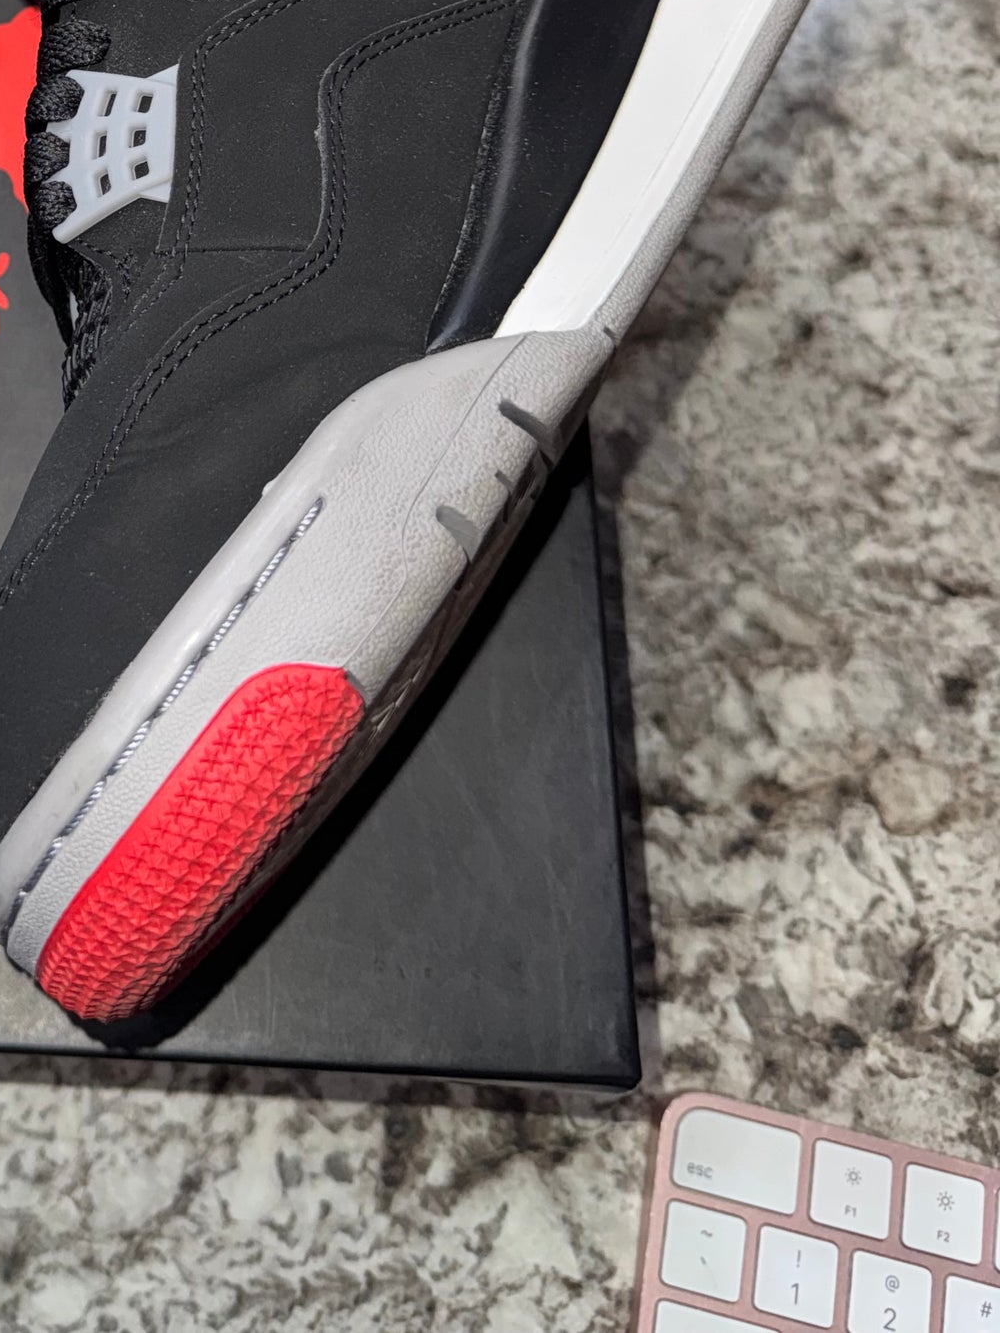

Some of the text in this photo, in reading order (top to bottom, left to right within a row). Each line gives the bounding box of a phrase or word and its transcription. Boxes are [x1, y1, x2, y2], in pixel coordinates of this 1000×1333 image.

[686, 1162, 713, 1180] esc
[844, 1204, 857, 1218] F1
[936, 1230, 950, 1243] F2
[884, 1275, 900, 1293] @
[791, 1282, 800, 1305] 1
[980, 1301, 993, 1318] #
[883, 1308, 897, 1332] 2
